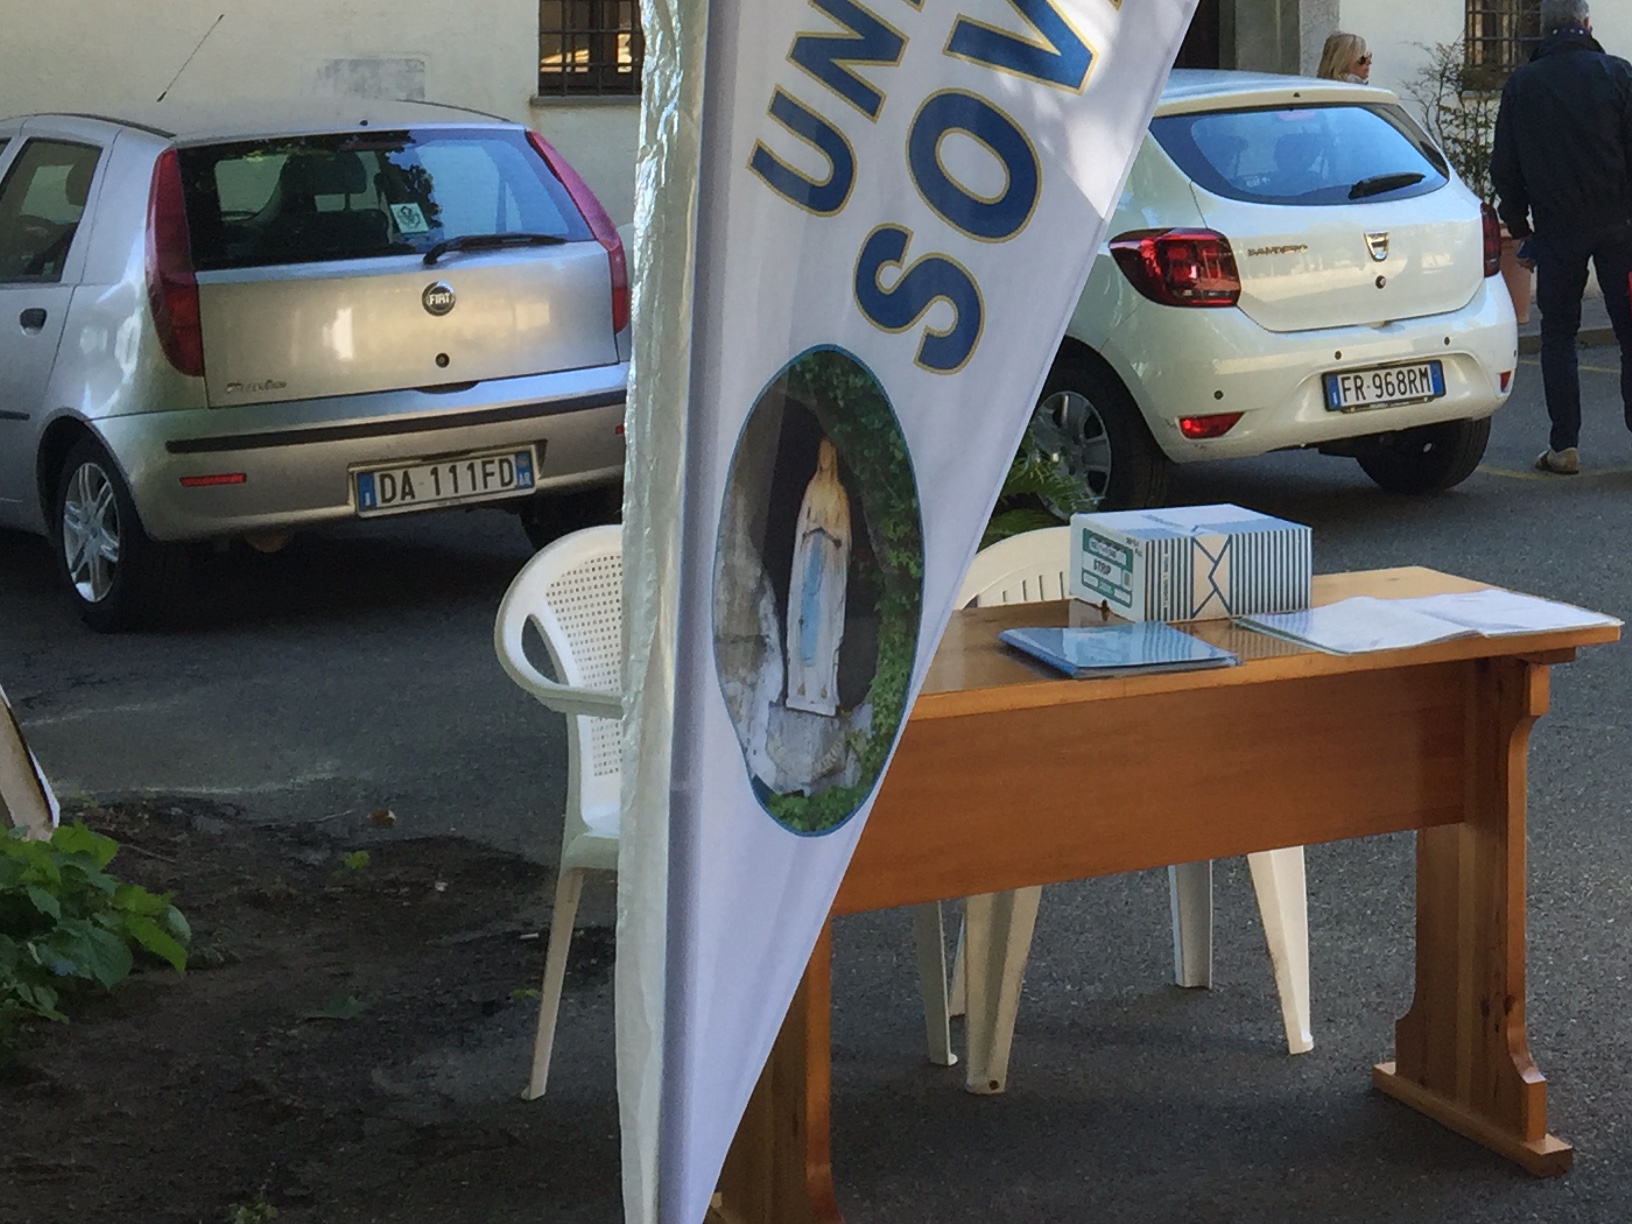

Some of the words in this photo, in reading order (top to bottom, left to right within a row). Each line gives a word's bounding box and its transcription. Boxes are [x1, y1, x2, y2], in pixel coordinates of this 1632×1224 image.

[428, 292, 451, 306] FIAT
[1340, 374, 1367, 403] FR
[1371, 366, 1432, 399] 968RM
[378, 469, 416, 504] DA
[429, 457, 514, 497] 111FD
